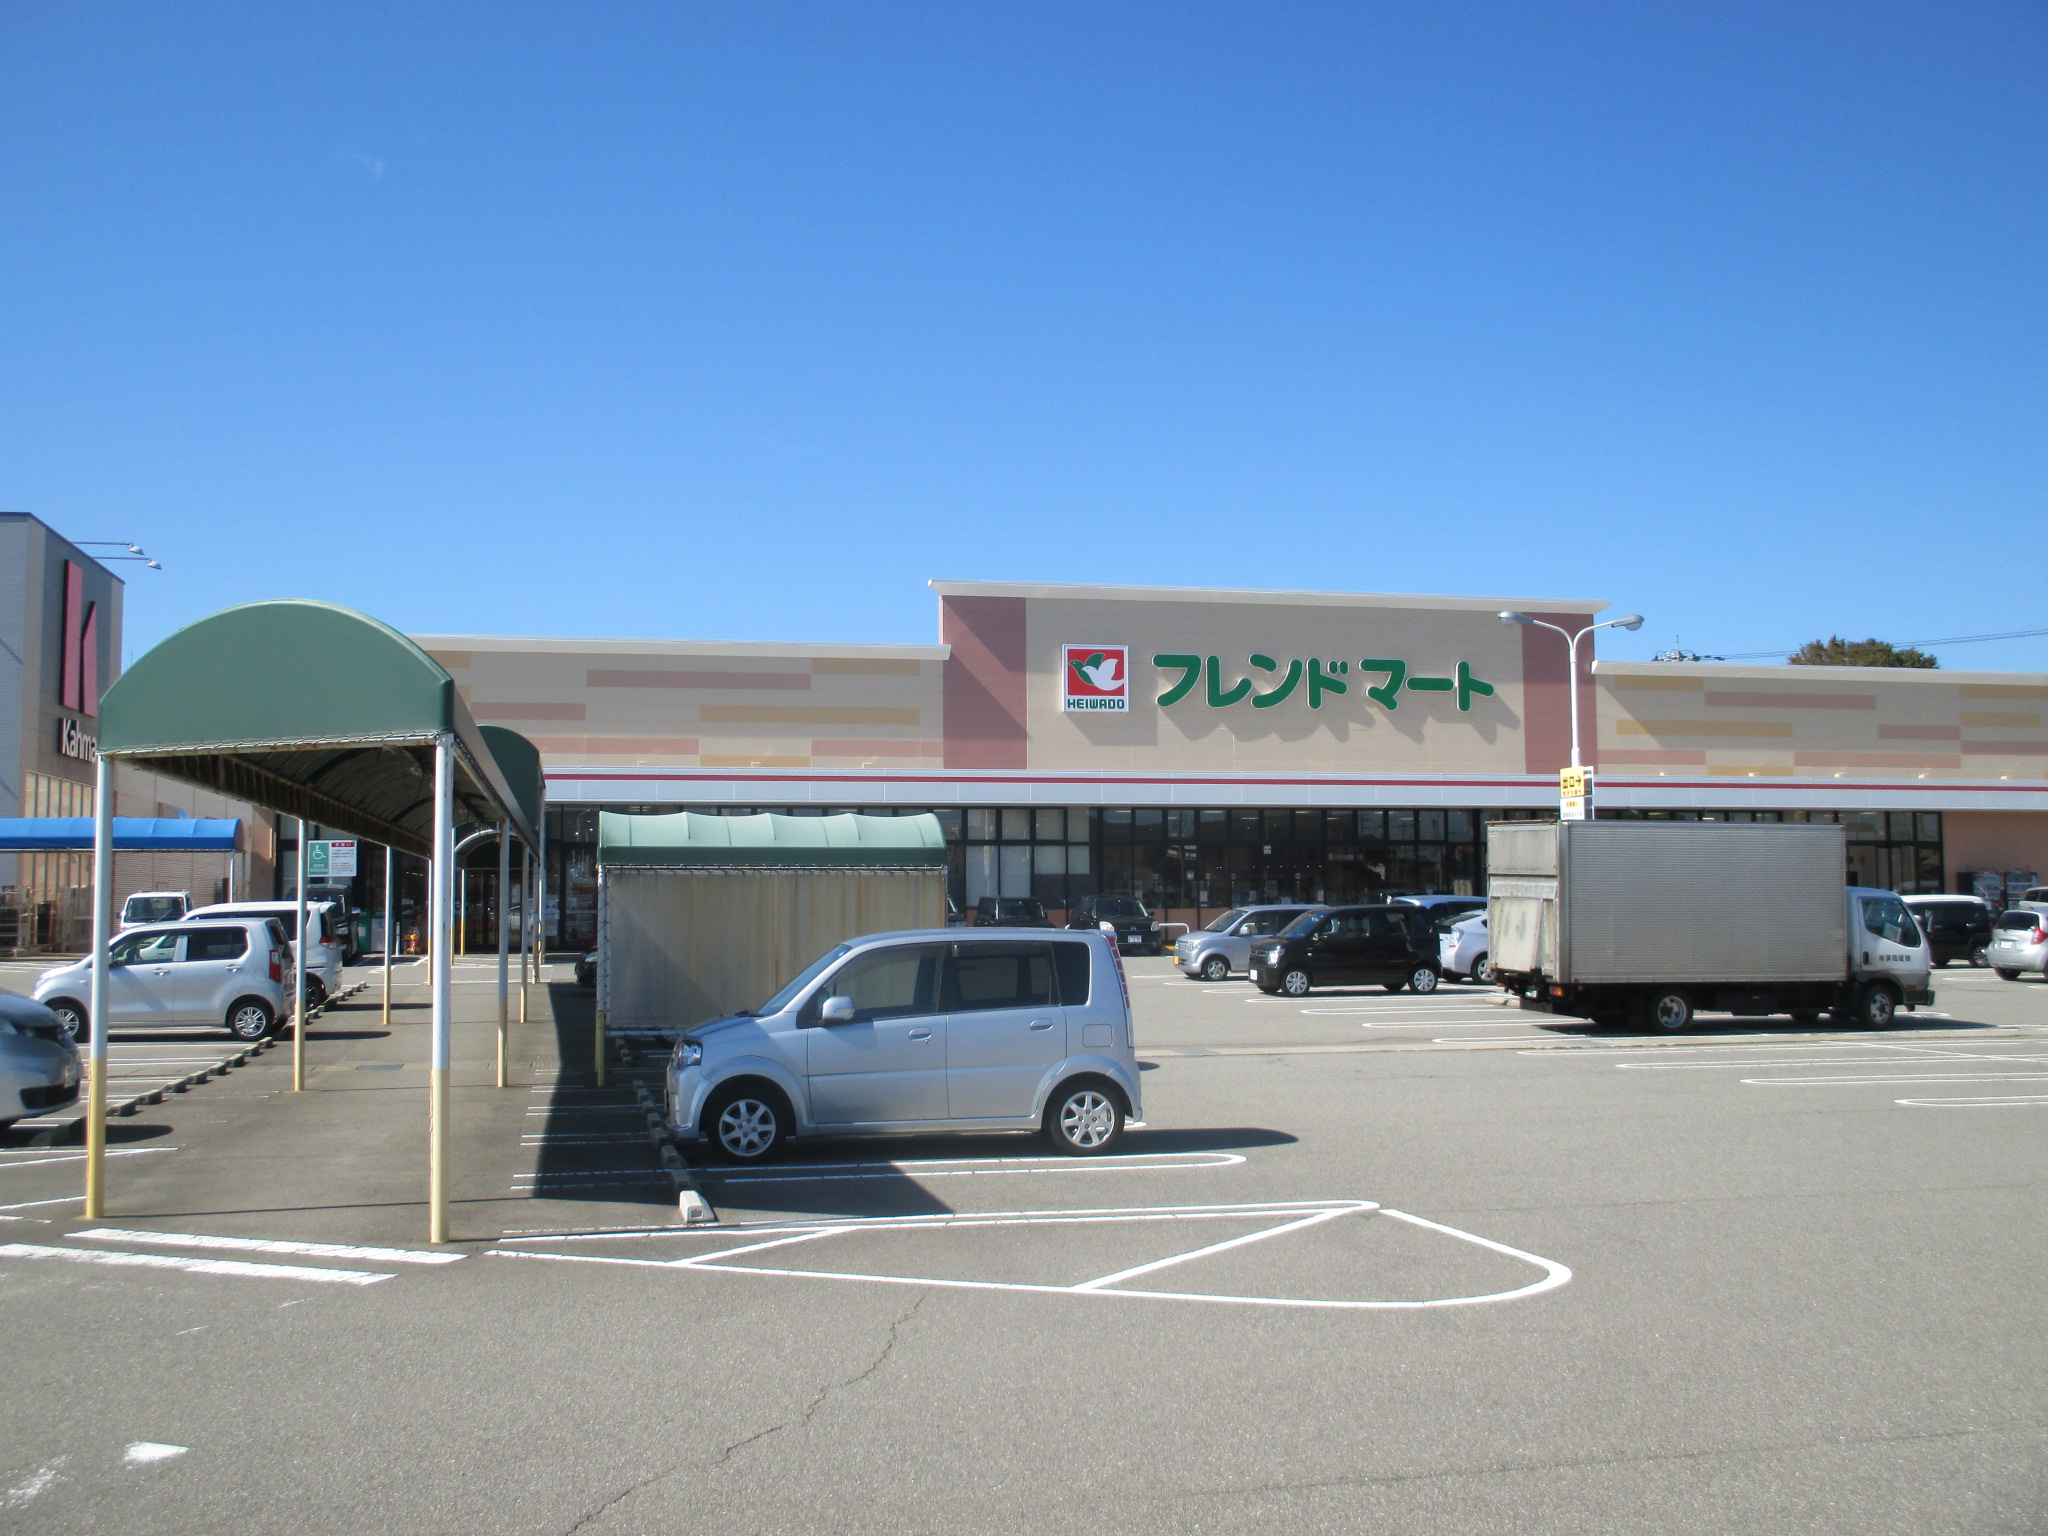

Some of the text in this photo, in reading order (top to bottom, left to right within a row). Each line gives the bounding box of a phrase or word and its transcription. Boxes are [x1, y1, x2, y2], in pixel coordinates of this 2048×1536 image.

[1152, 653, 1495, 712] フレンドマート
[1067, 698, 1125, 710] HEIWADO
[62, 718, 98, 763] Kahma
[1562, 776, 1574, 789] 出口
